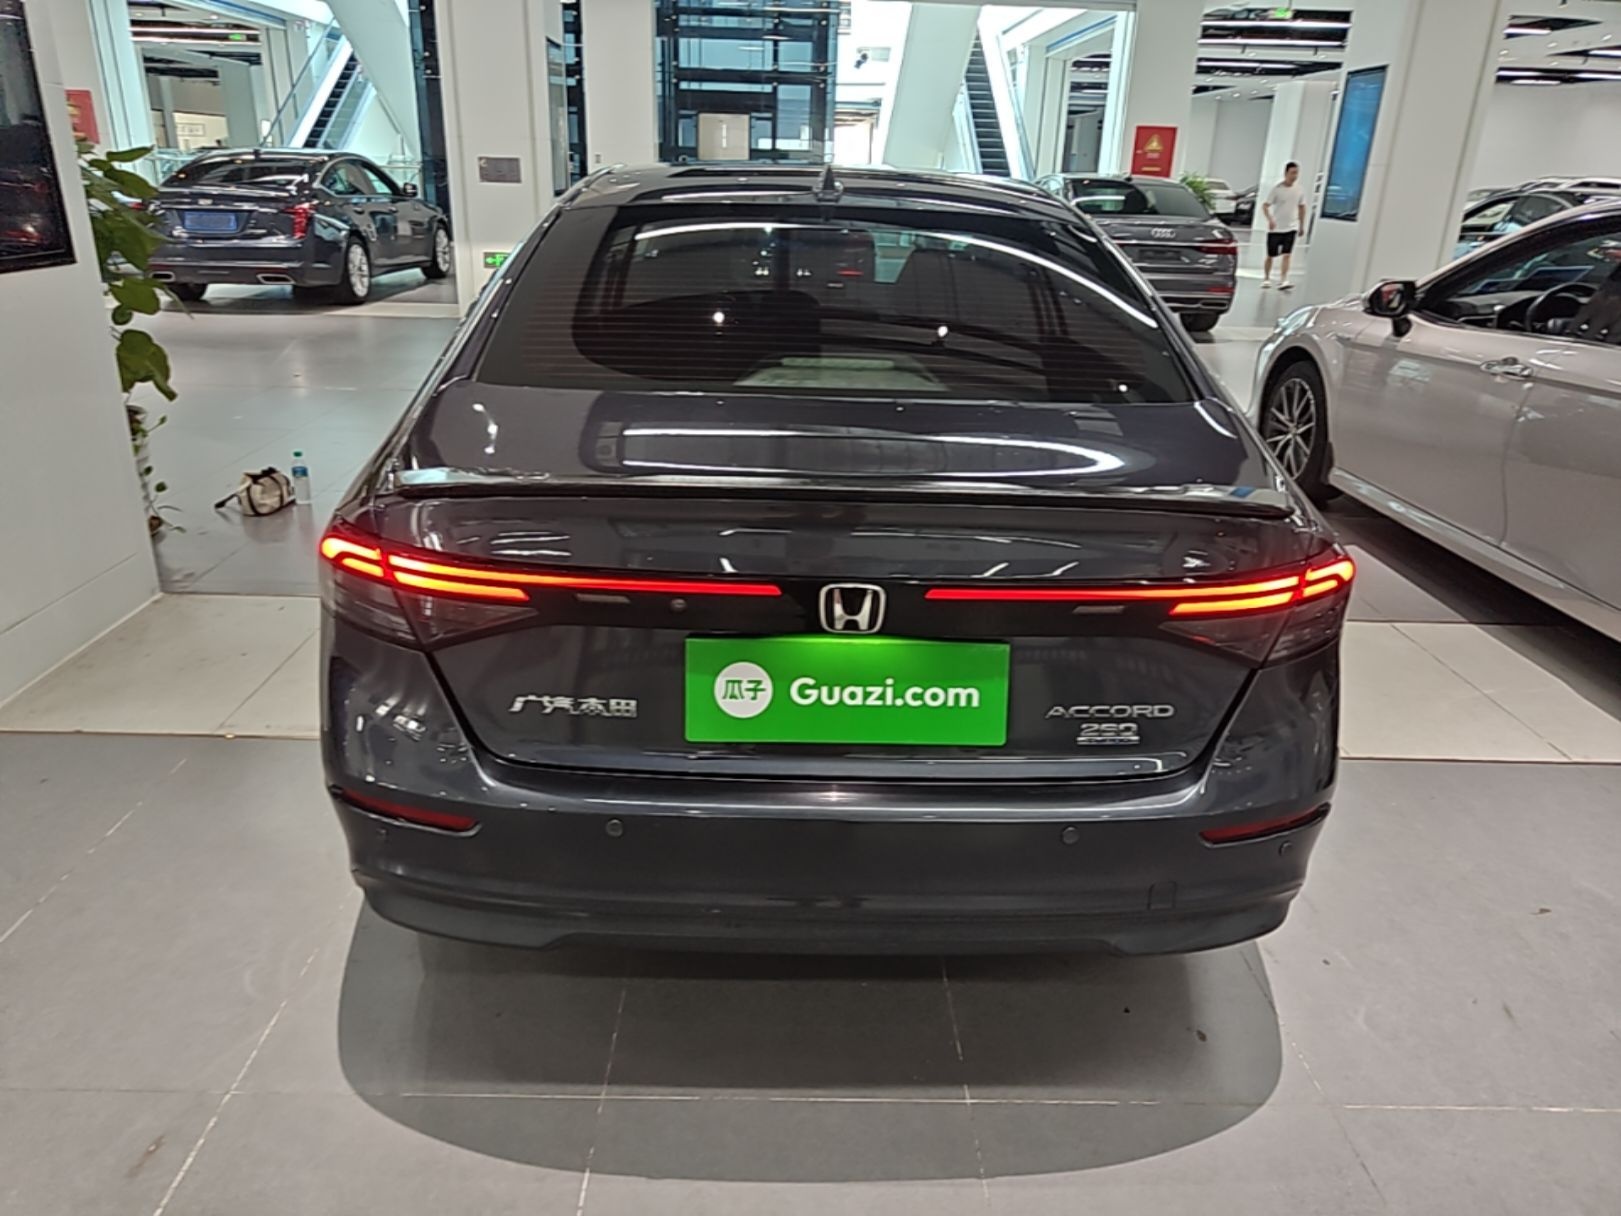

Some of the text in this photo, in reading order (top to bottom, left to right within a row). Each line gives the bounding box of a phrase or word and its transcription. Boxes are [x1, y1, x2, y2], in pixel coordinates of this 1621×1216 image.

[722, 678, 767, 701] 瓜子
[789, 677, 980, 708] Guazi.com
[508, 695, 638, 718] 广汽本田
[1044, 704, 1175, 719] ACCORD
